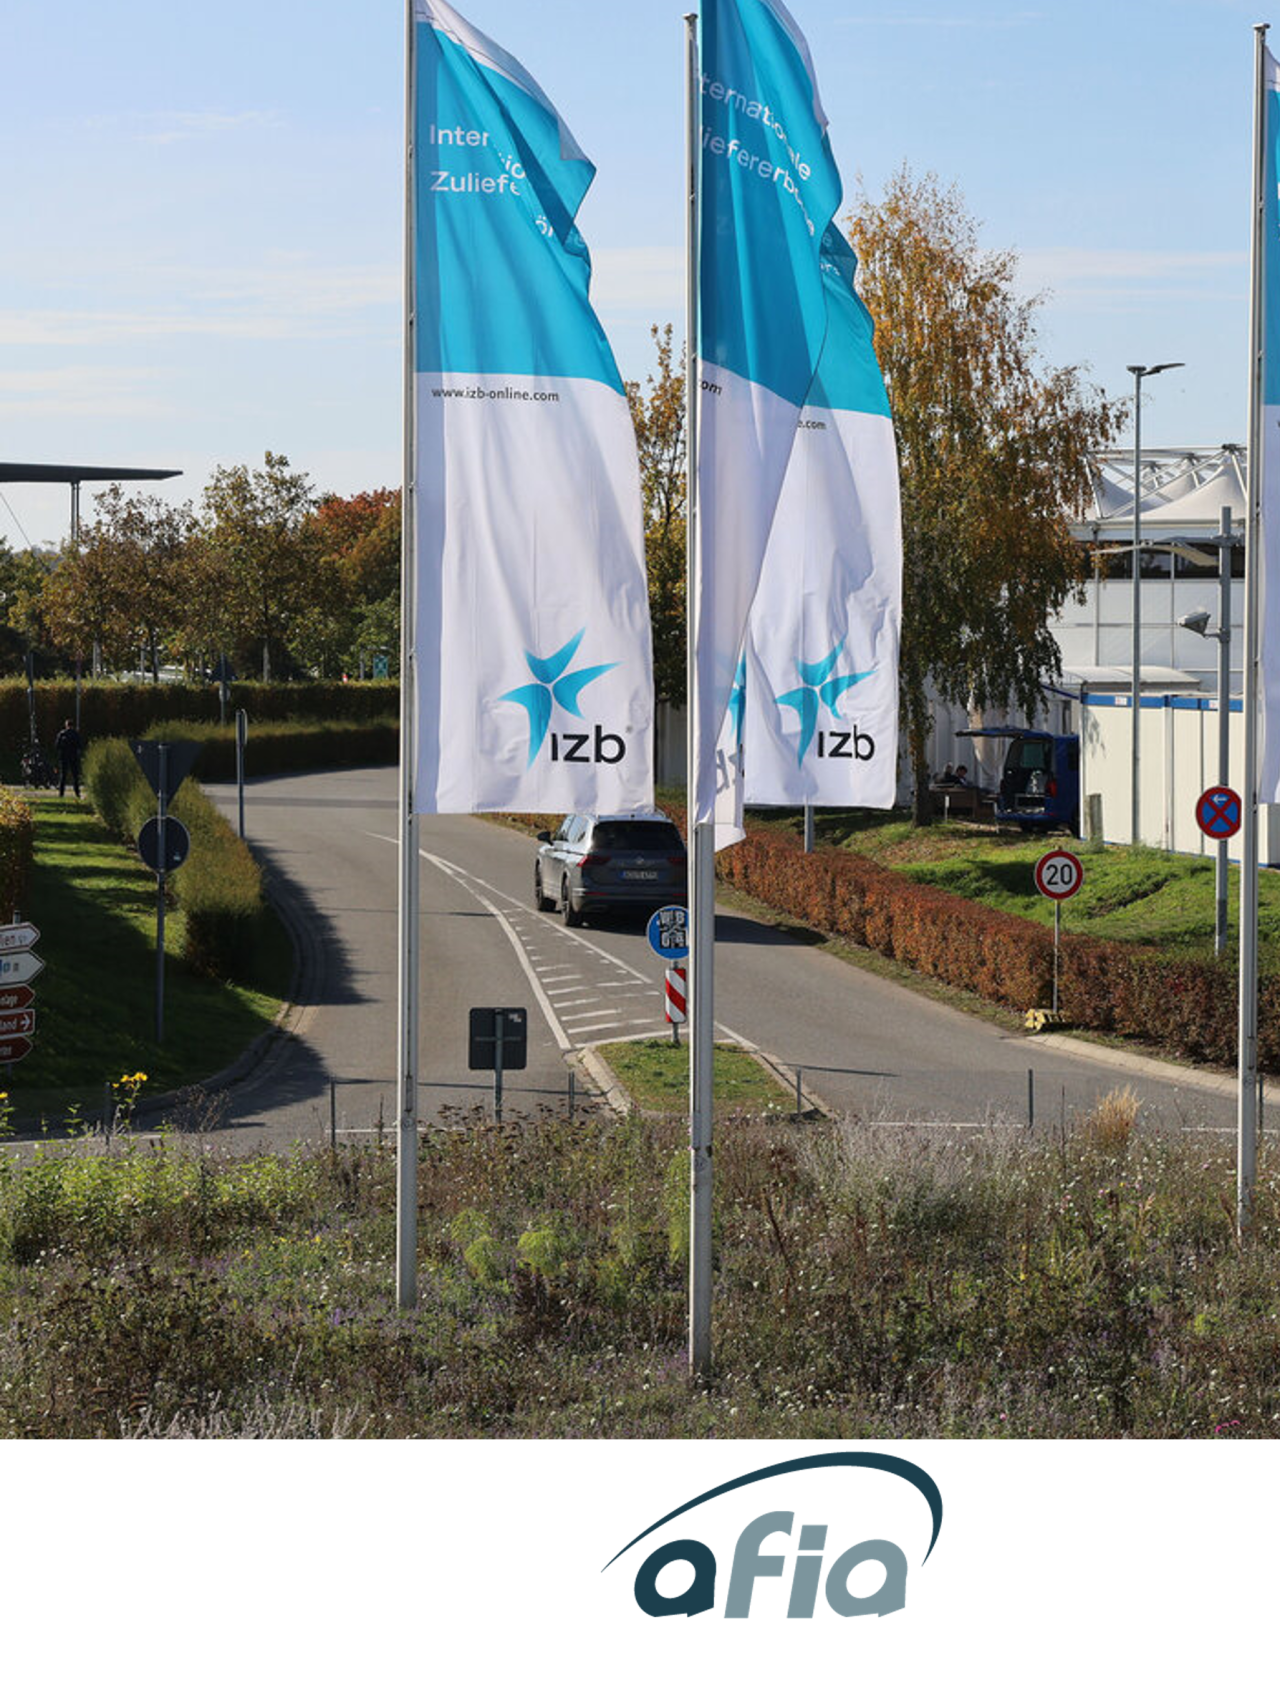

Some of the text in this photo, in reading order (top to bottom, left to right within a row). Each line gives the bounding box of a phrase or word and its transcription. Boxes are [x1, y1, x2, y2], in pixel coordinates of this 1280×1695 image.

[431, 387, 560, 401] www.izb-online.com
[550, 724, 627, 764] izb
[817, 724, 875, 761] izb
[1046, 864, 1072, 885] 20
